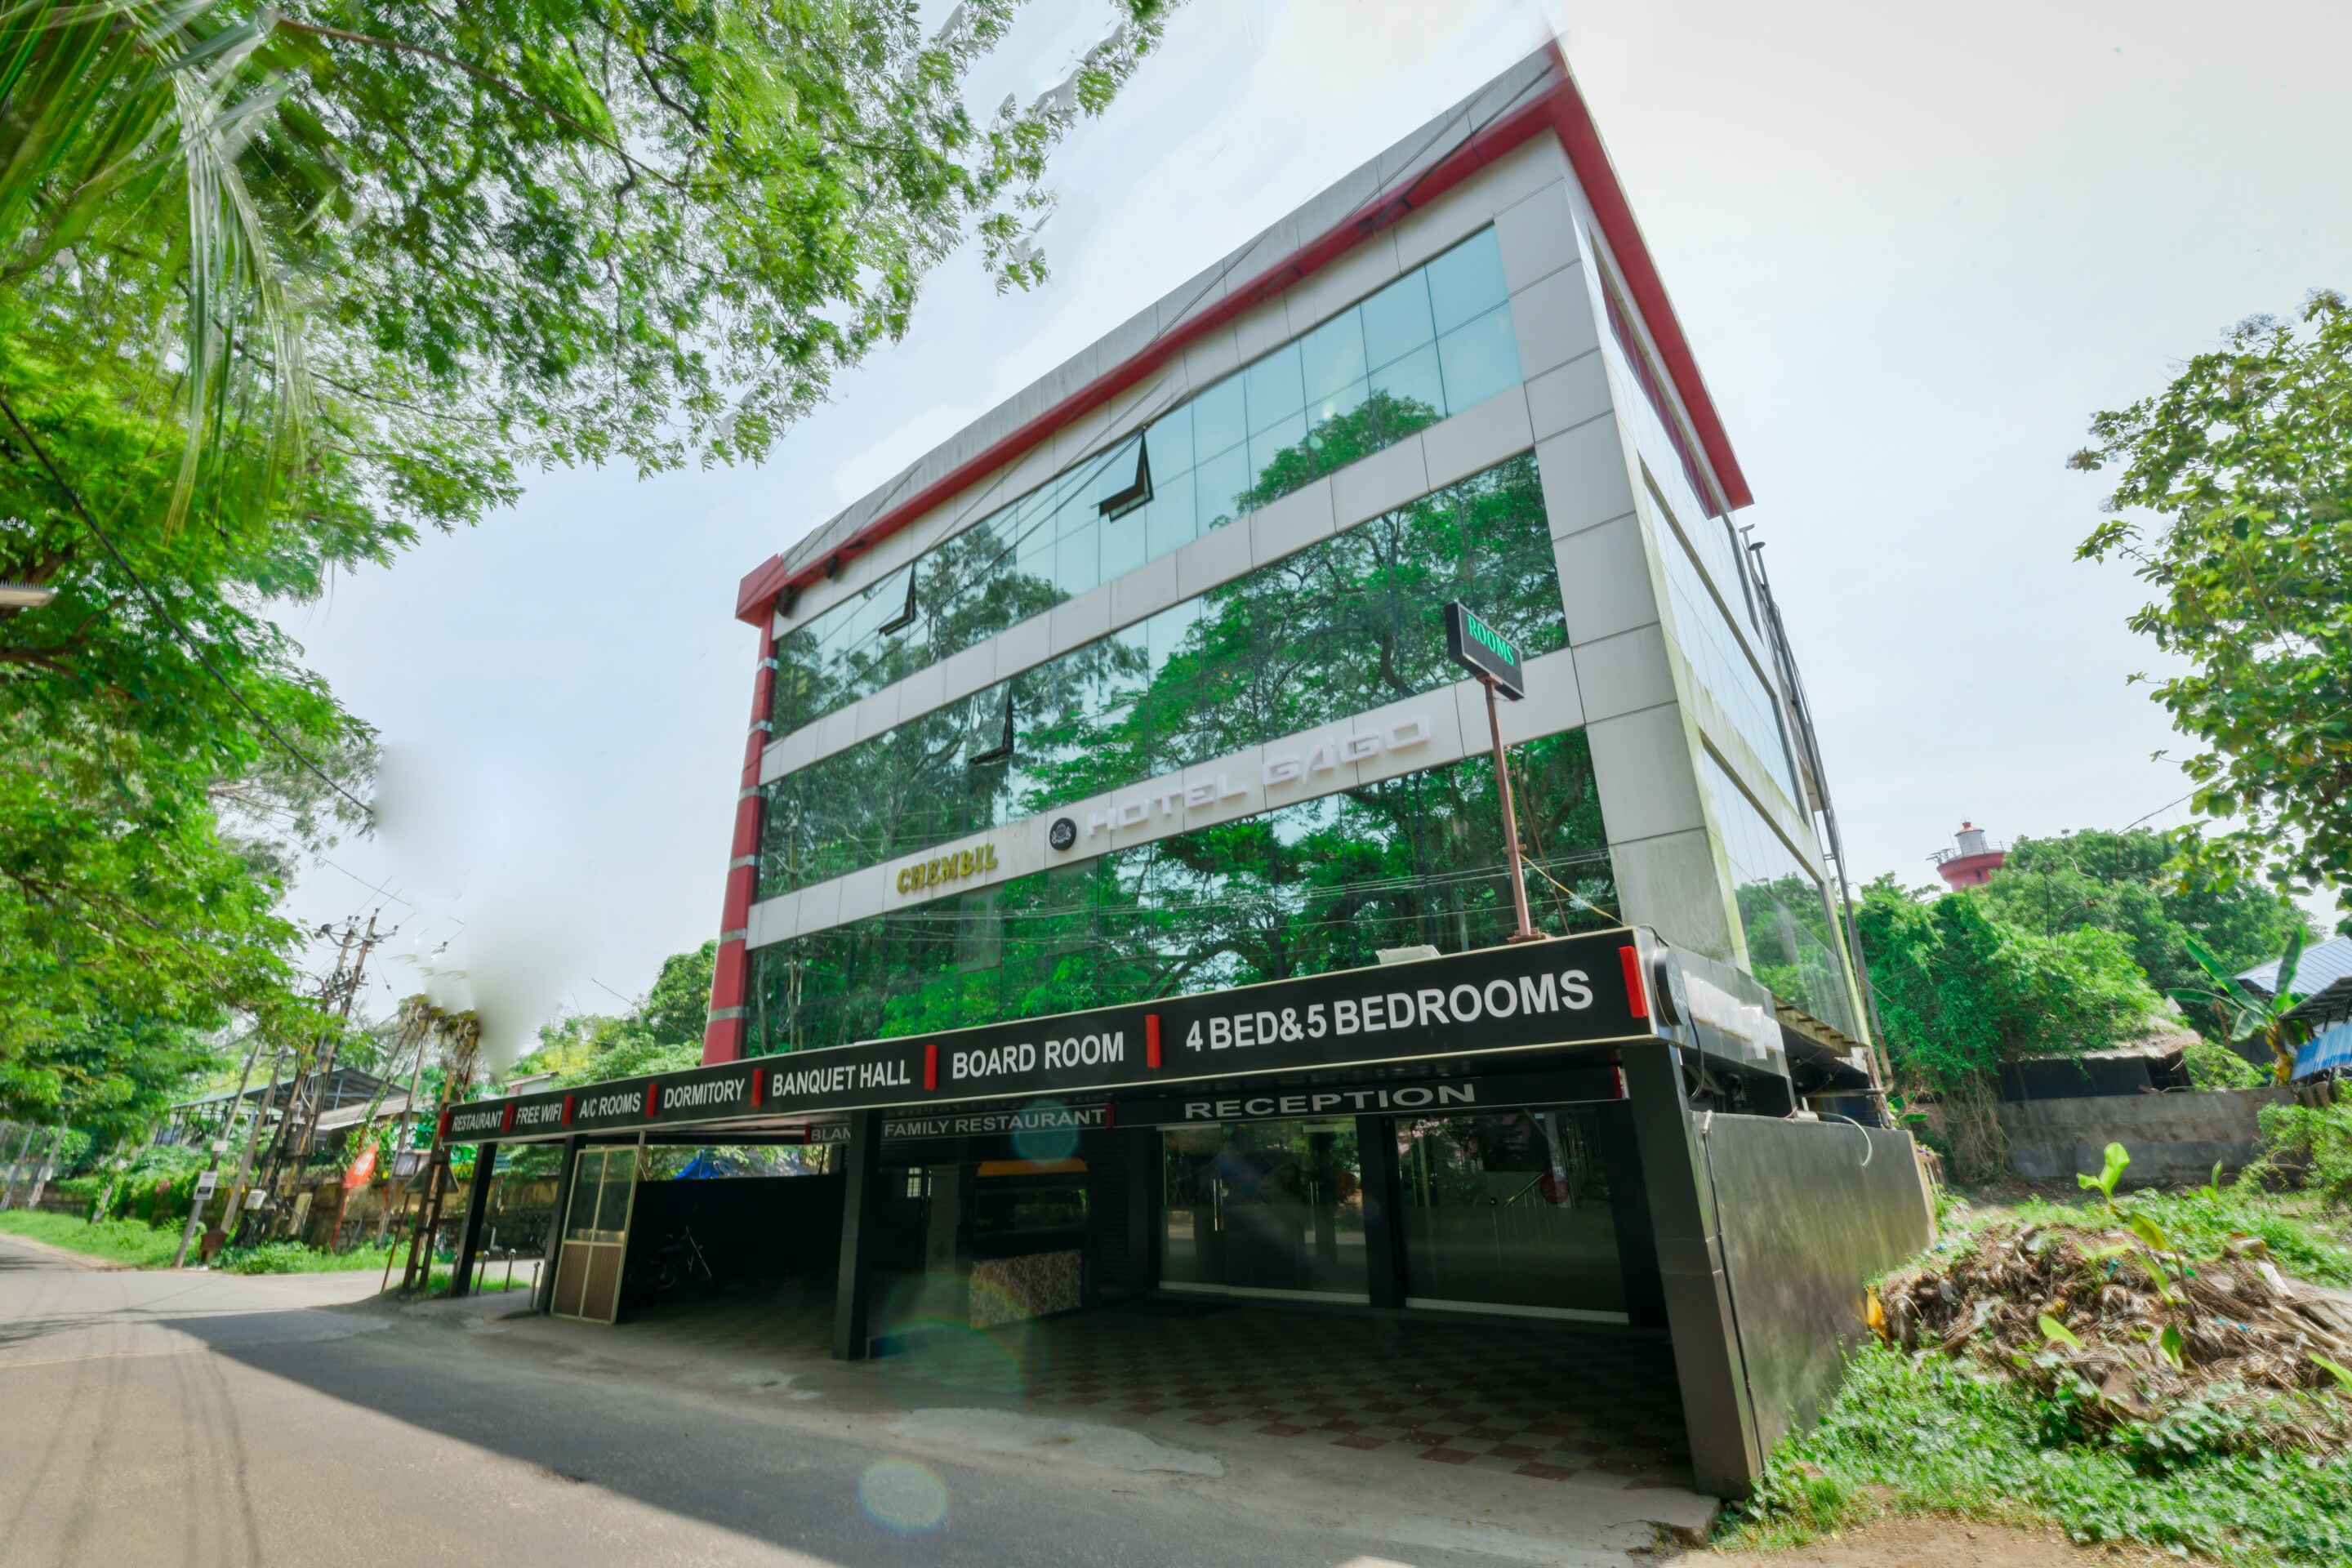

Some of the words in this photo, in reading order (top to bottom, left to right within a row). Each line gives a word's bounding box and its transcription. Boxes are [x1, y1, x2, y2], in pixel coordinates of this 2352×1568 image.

[1468, 613, 1514, 666] ROOMS
[1086, 774, 1248, 837] HOTEL
[897, 842, 998, 894] CHEMBIL
[952, 1044, 1036, 1080] BOARD
[1045, 1031, 1124, 1069] ROOM
[664, 1078, 745, 1109] DORMITORY
[772, 1065, 856, 1097] BANQUET
[860, 1059, 911, 1089] HALL
[516, 1105, 540, 1125] FREE
[541, 1102, 562, 1122] WIFI
[579, 1098, 597, 1119] A/C
[599, 1092, 641, 1116] ROOMS
[1185, 1083, 1475, 1120] RECEPTION
[452, 1110, 503, 1132] RESTAURANT
[884, 1120, 950, 1138] FAMILY
[956, 1109, 1107, 1133] RESTAURANT
